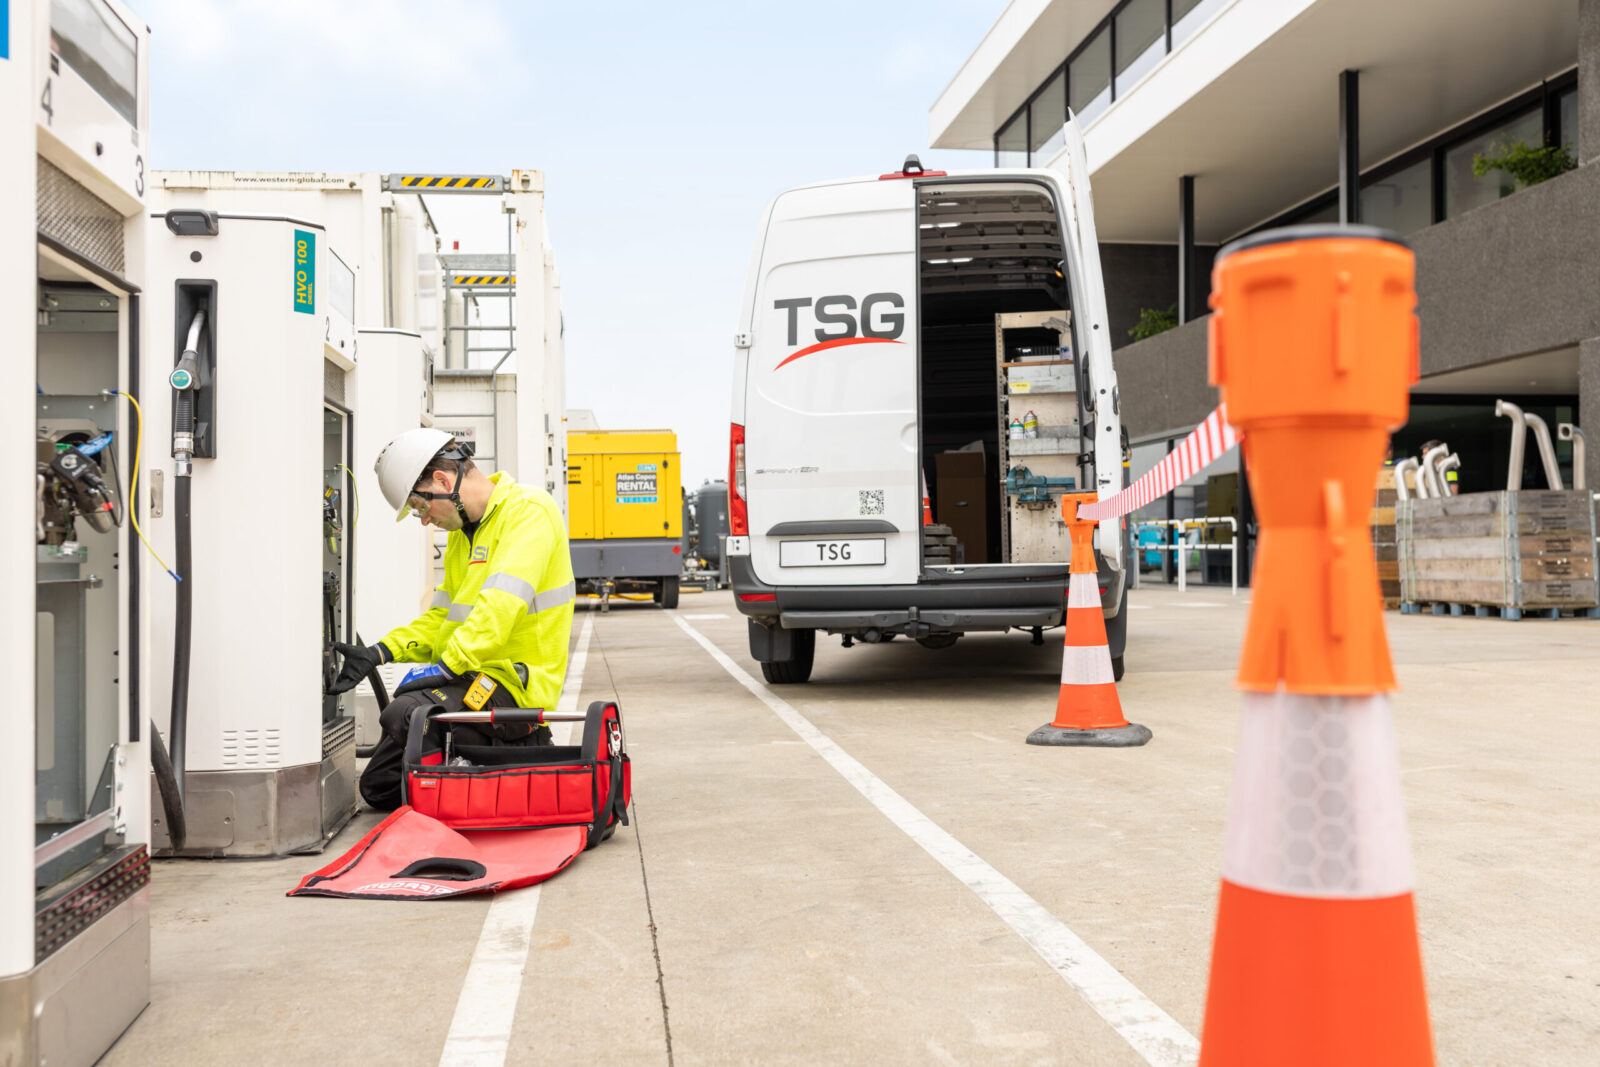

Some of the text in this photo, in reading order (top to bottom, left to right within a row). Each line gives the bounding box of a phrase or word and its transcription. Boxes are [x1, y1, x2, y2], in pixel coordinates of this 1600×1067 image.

[41, 77, 53, 126] 4
[136, 154, 144, 198] 3
[297, 240, 307, 304] HVO 100
[774, 292, 905, 346] TSG
[617, 481, 657, 491] RENTAL
[816, 543, 852, 561] TSG
